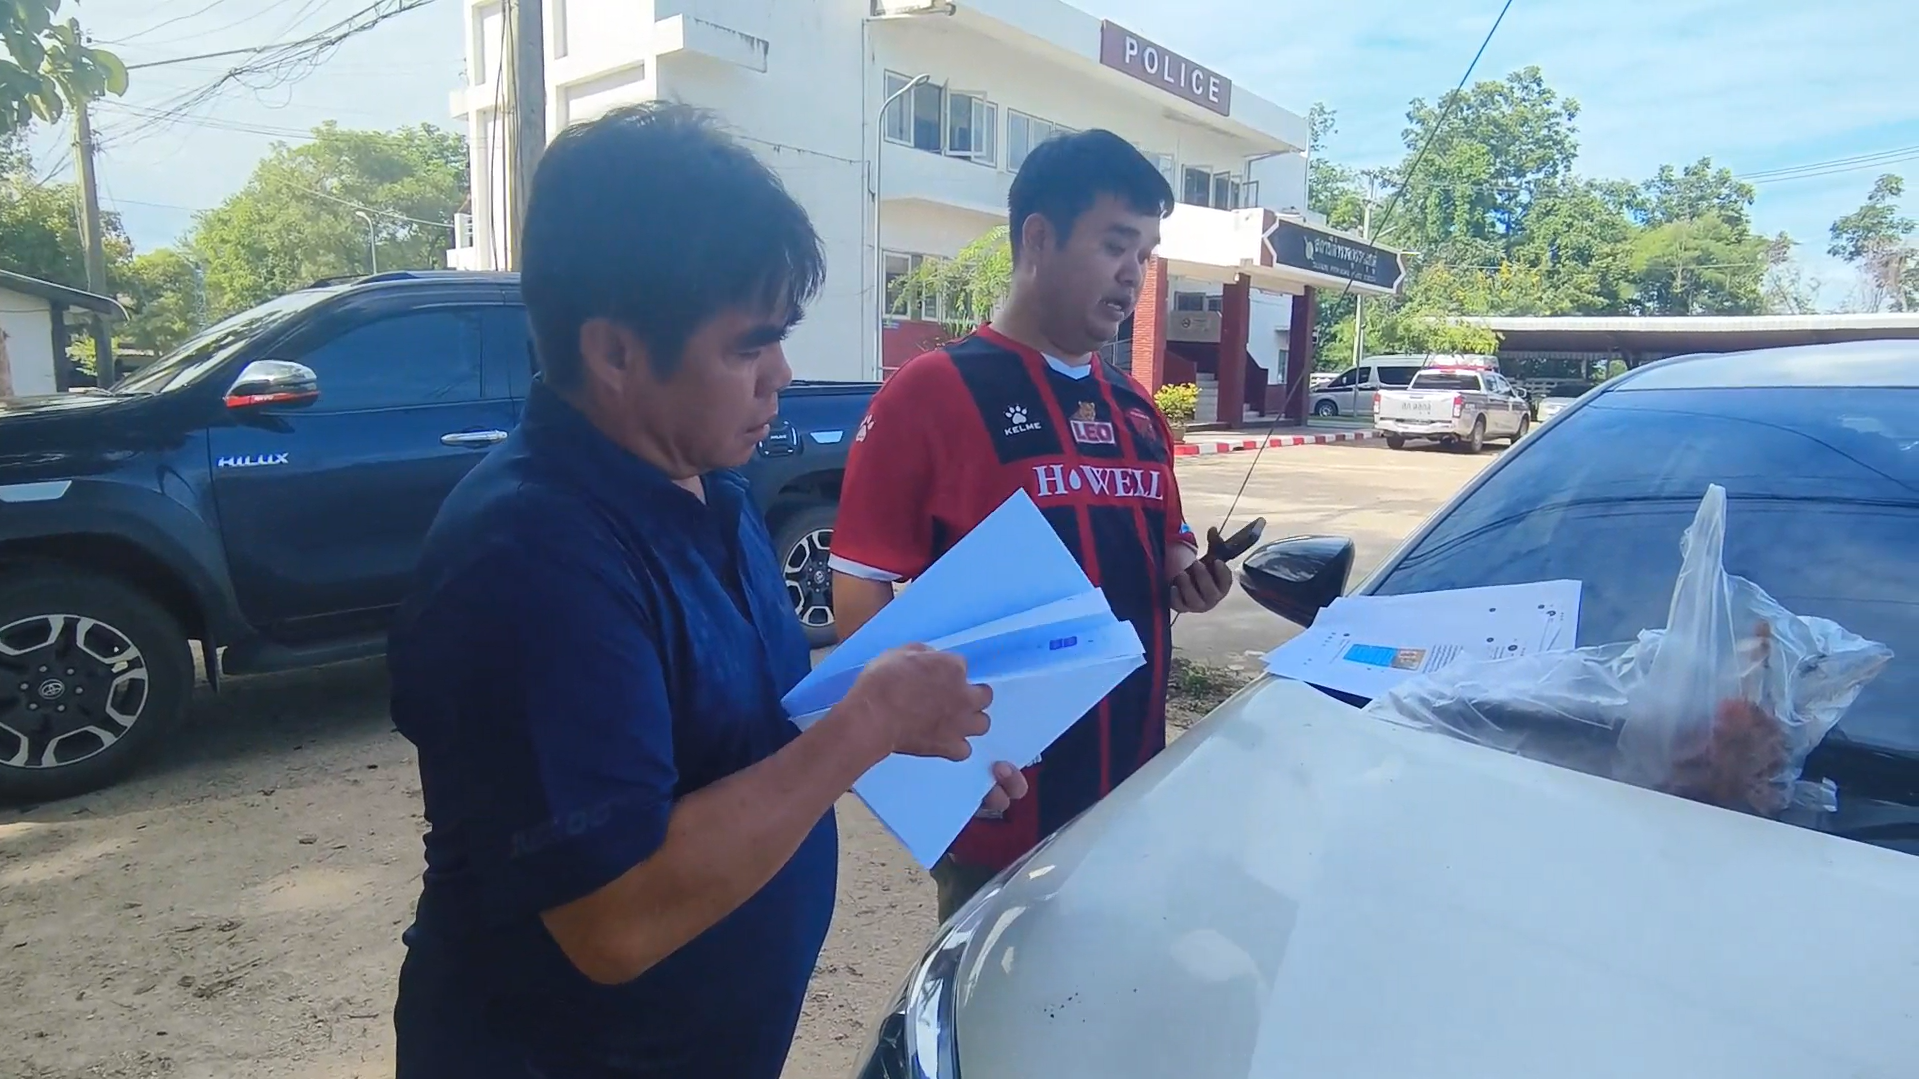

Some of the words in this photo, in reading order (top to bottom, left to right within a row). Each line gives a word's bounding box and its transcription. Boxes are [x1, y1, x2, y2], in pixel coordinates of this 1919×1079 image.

[1125, 36, 1220, 103] POLICE
[1004, 422, 1042, 436] KELME
[1073, 423, 1111, 442] LEO
[217, 452, 289, 467] HILUX
